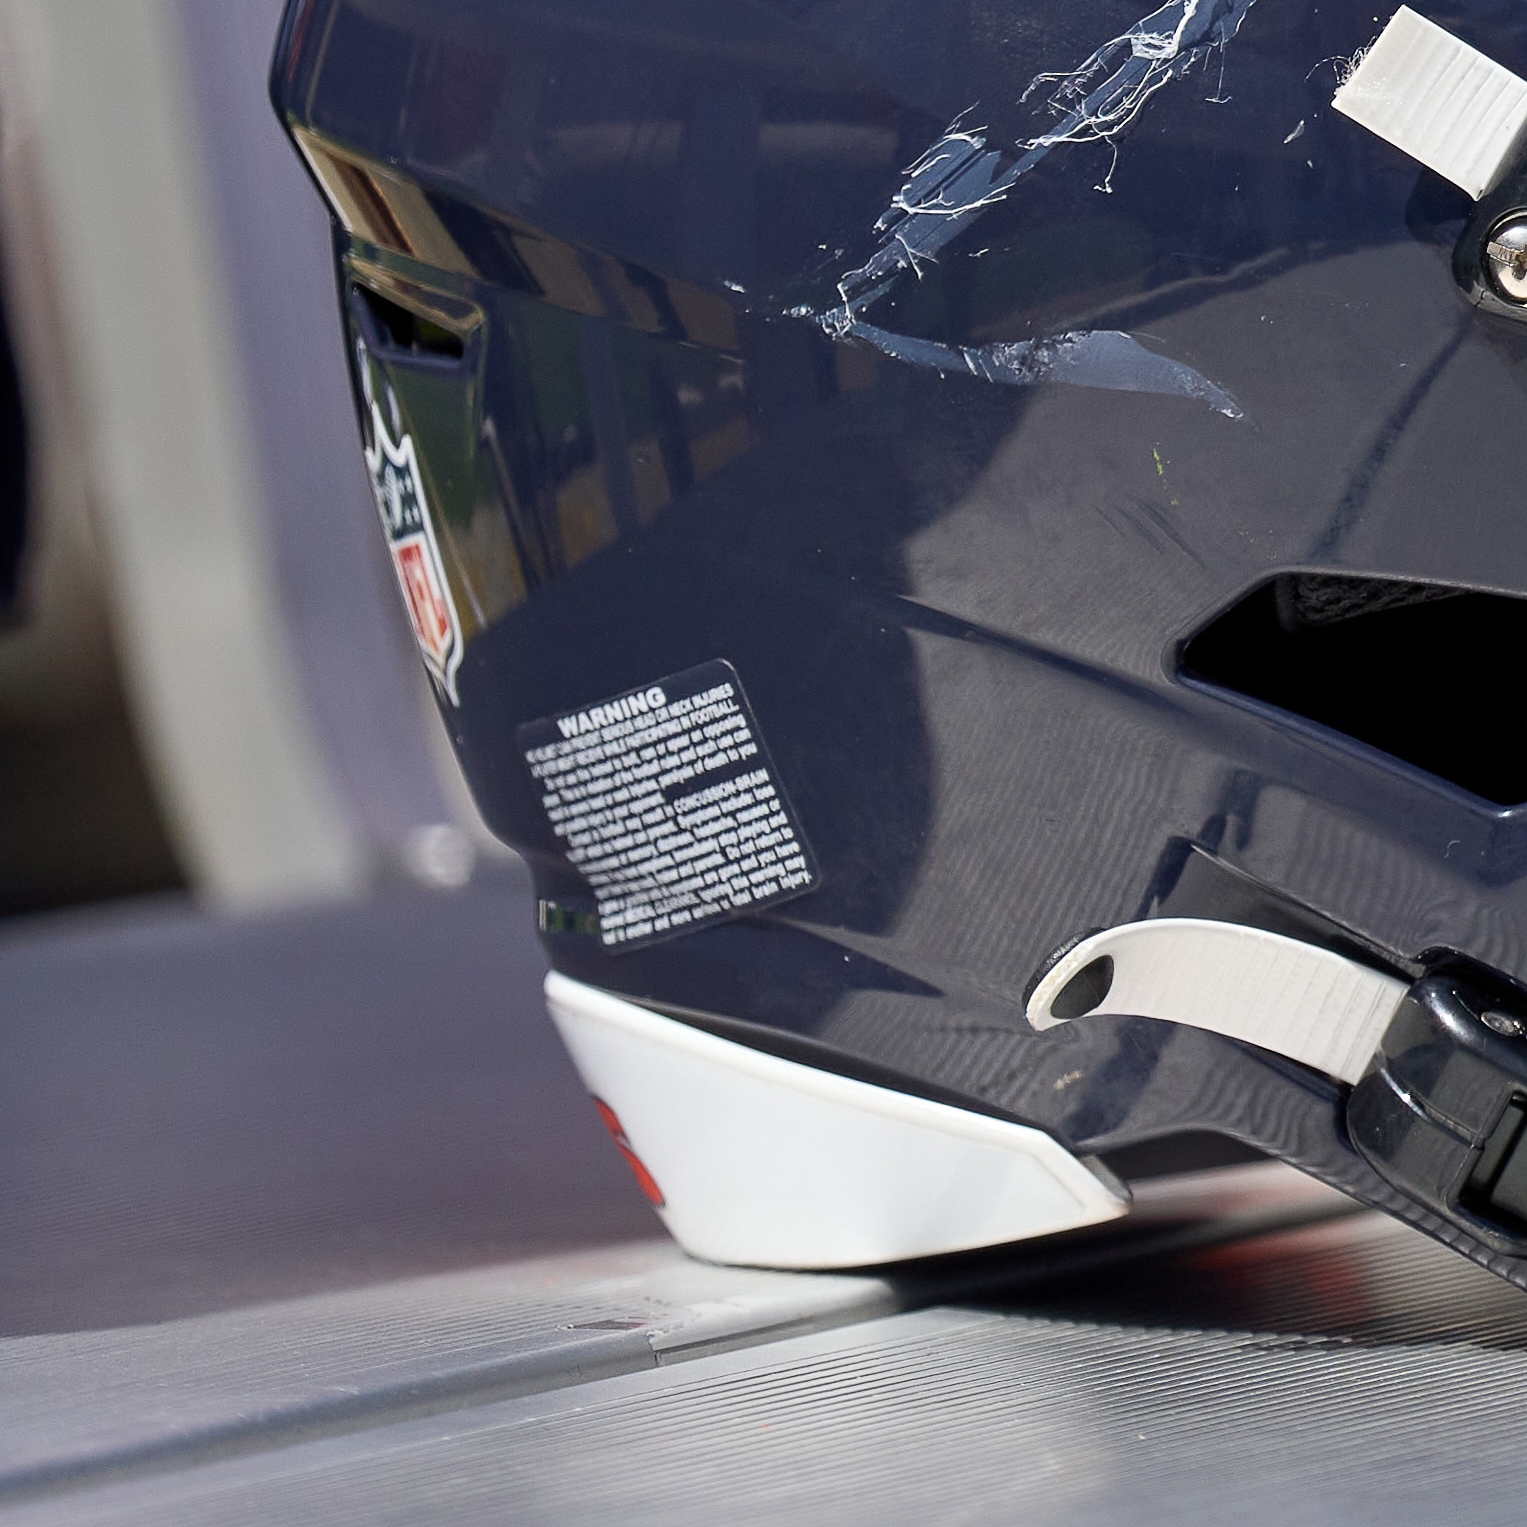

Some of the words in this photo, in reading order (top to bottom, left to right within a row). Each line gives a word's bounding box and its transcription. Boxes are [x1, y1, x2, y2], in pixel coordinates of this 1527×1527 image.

[691, 683, 734, 708] INJURIES
[556, 686, 667, 738] WARNING
[738, 742, 757, 760] you
